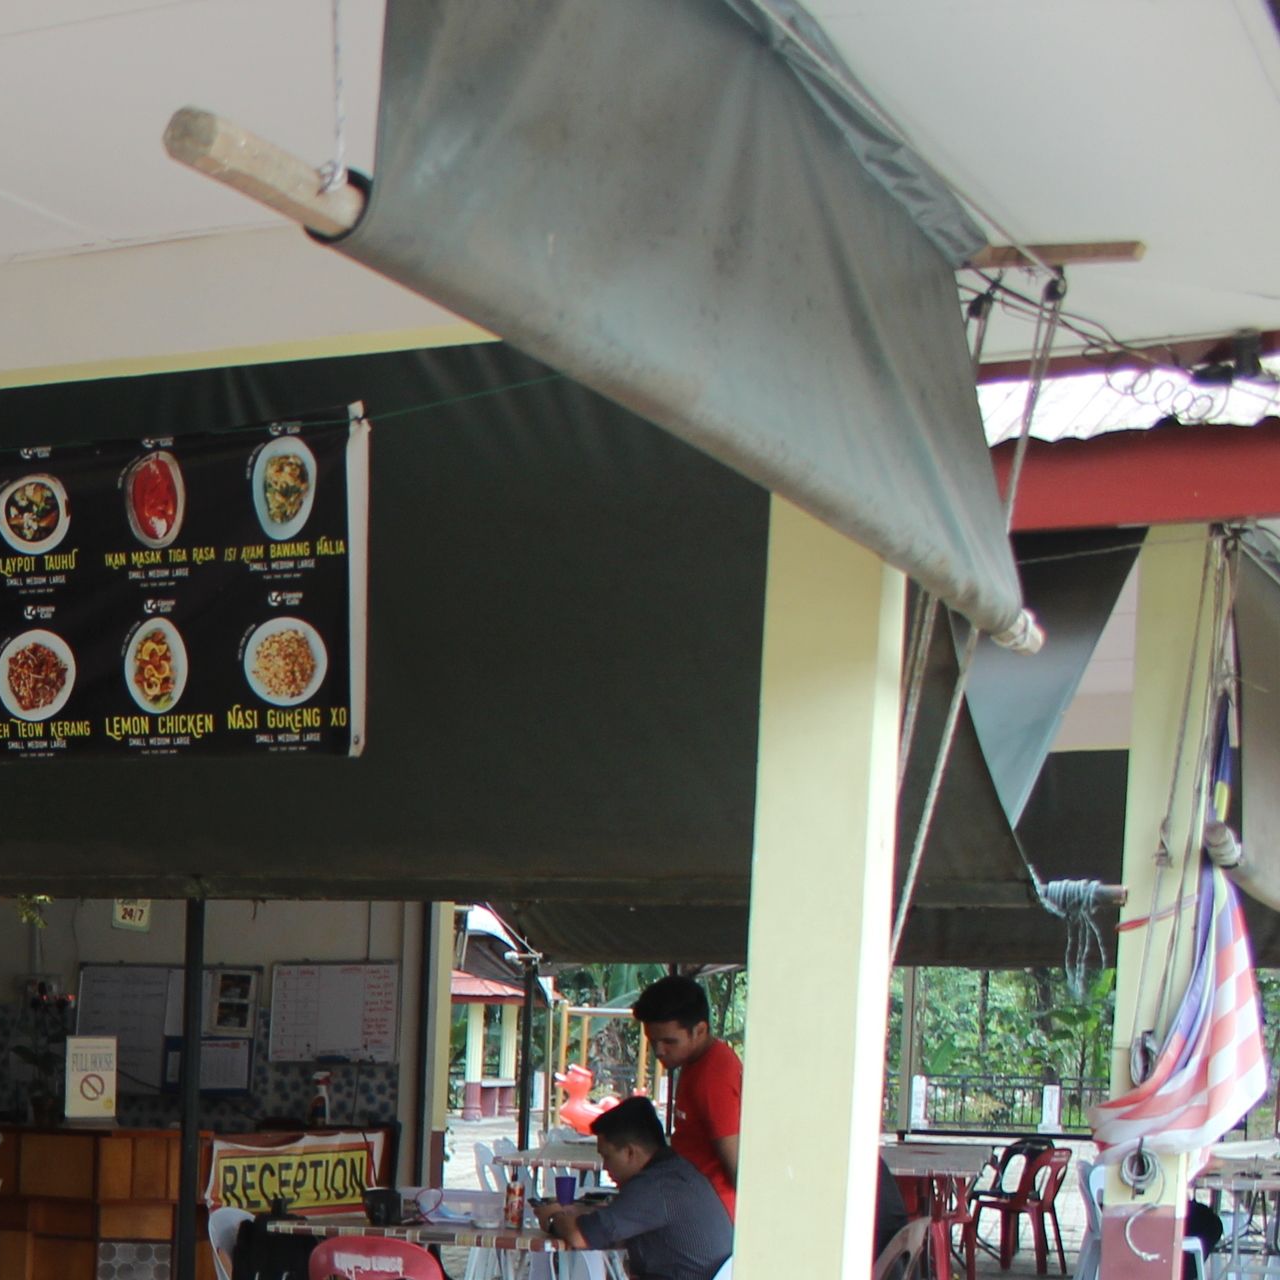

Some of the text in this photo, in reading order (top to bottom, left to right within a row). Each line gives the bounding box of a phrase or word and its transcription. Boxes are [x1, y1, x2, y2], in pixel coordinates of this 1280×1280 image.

[44, 549, 78, 571] TAUHU
[105, 548, 216, 570] IKAN MASAK TIGA RASA
[224, 536, 345, 564] ISI AYAM BAWANG HALIA
[10, 718, 43, 738] TEOW
[50, 721, 90, 742] KERANG
[105, 714, 213, 740] LEMON CHICKEN
[227, 704, 347, 733] NASI GORENG XO
[72, 1053, 114, 1072] FULL HOUSE
[222, 1156, 364, 1209] RECEPTION
